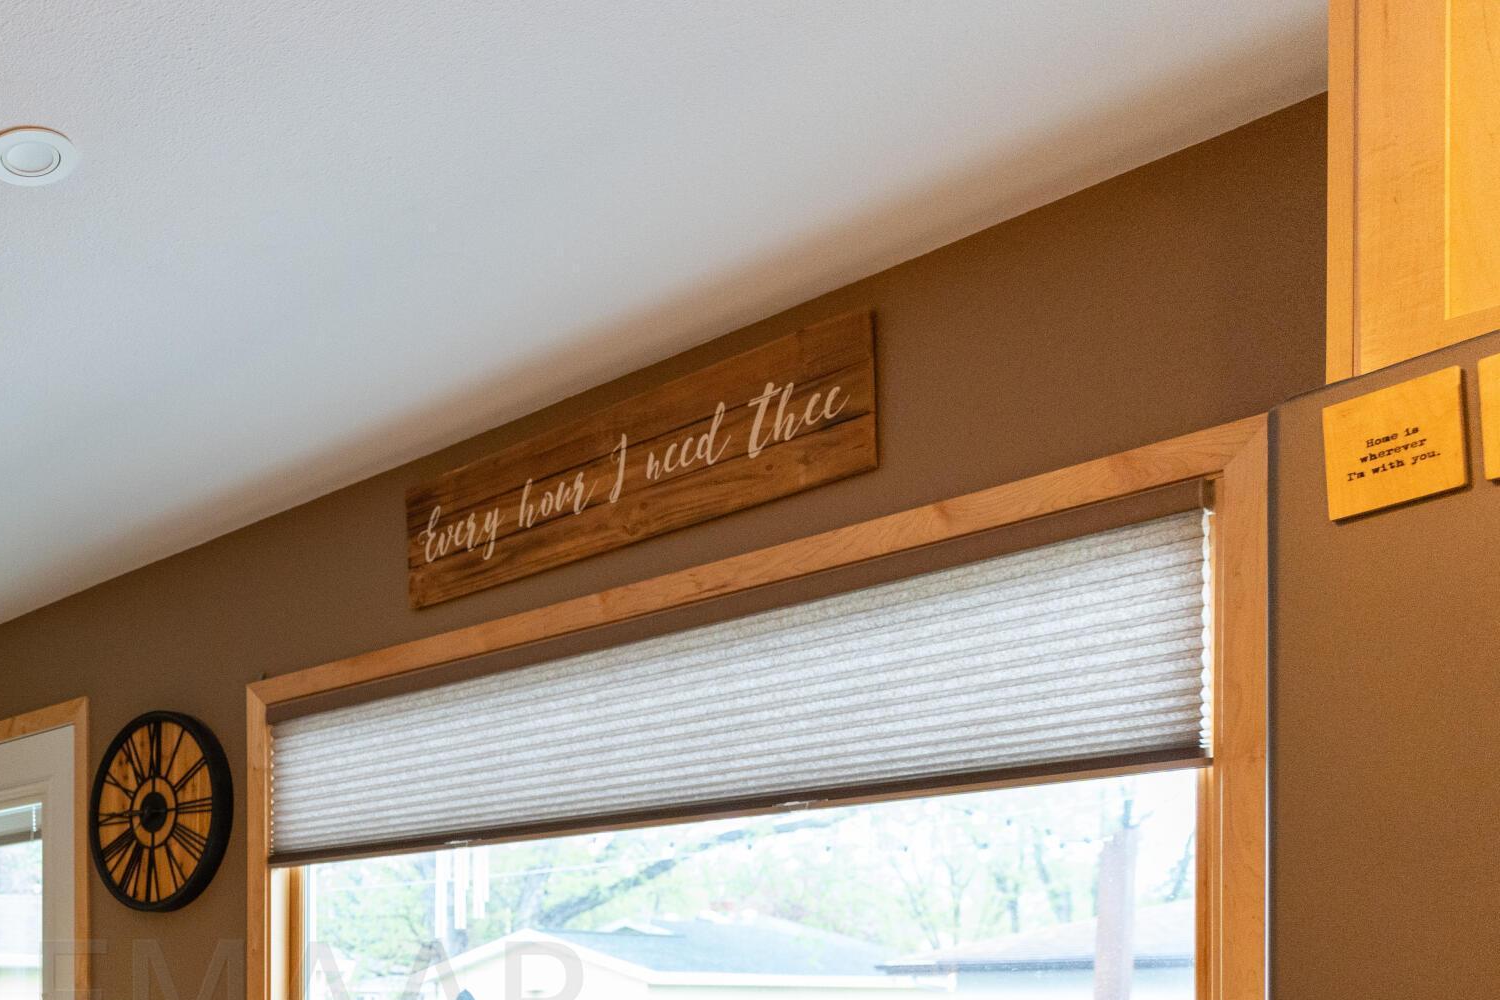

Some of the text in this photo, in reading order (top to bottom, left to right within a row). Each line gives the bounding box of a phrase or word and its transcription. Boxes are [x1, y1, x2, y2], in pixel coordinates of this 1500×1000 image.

[1360, 438, 1427, 463] wherever
[1366, 427, 1419, 448] Home is
[518, 471, 599, 530] hour
[609, 433, 628, 504] I
[646, 401, 732, 482] need
[1347, 450, 1441, 482] I'm with you.
